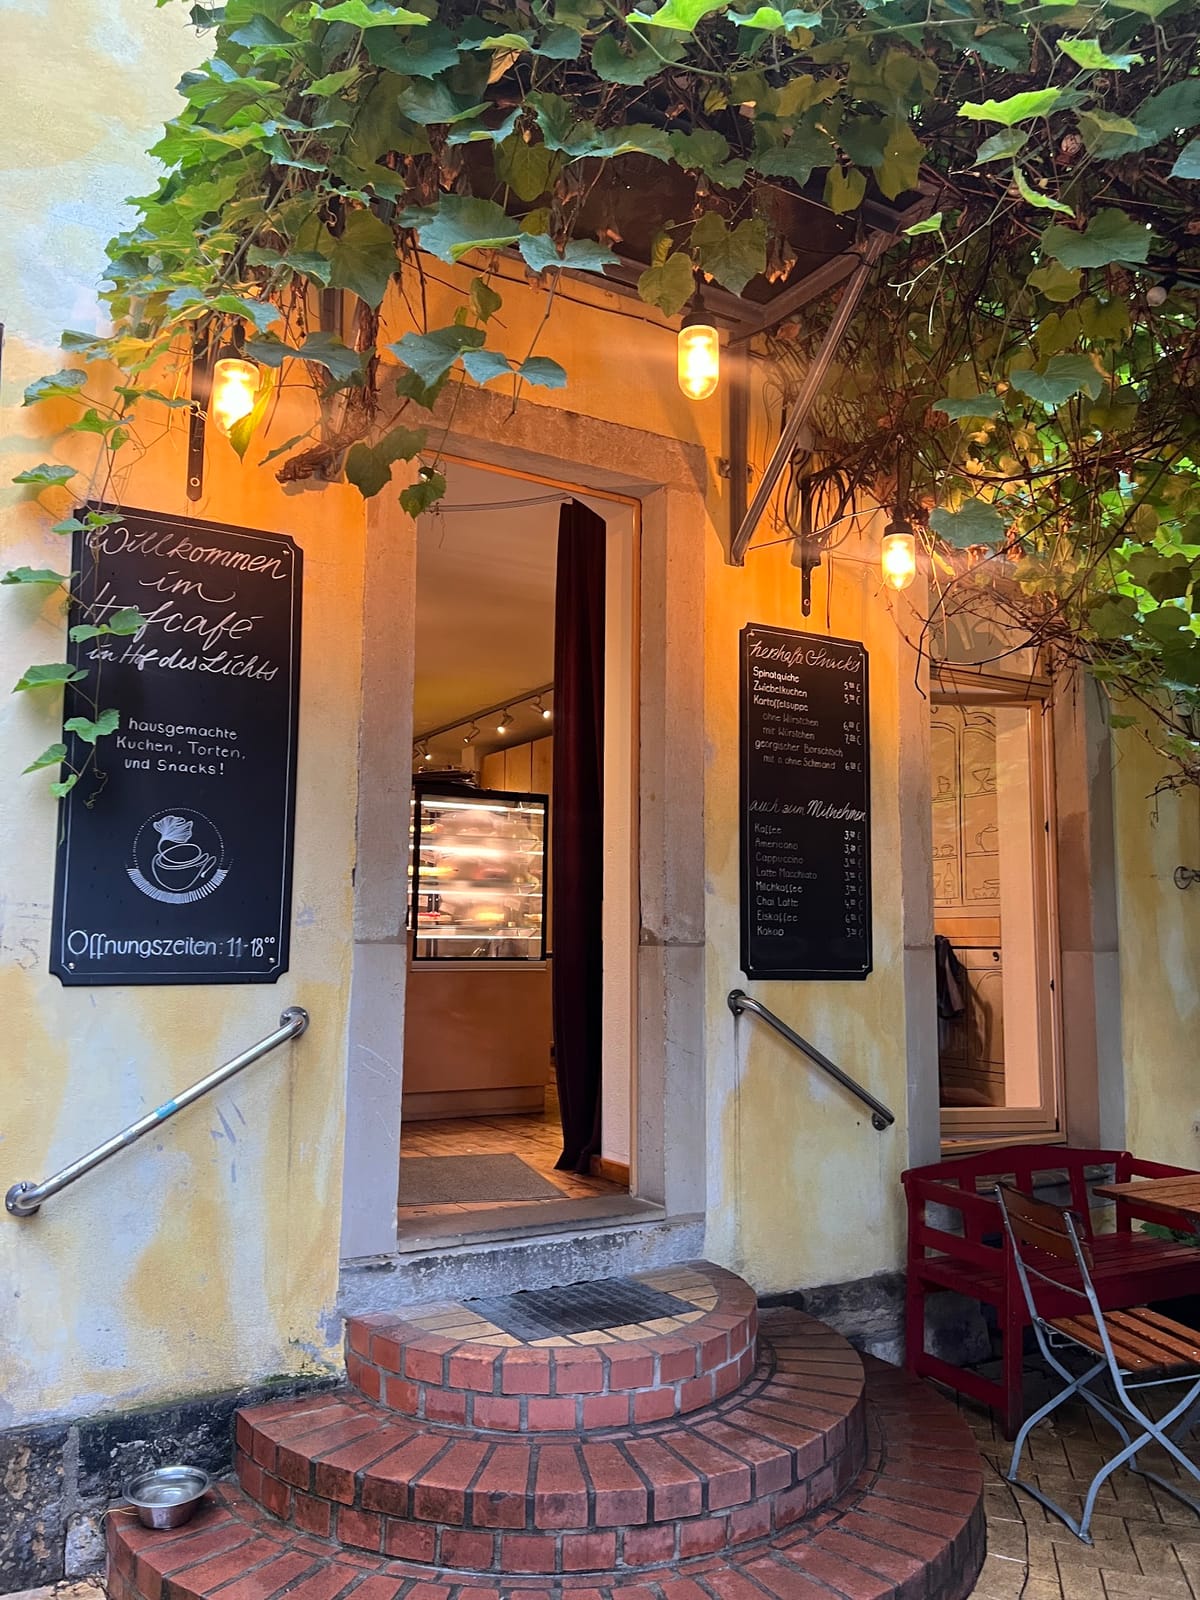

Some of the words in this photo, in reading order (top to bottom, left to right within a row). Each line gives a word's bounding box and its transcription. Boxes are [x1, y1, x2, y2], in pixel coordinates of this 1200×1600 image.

[85, 524, 287, 579] Willkommen
[139, 571, 236, 602] im
[83, 582, 264, 651] Hfcafé
[159, 650, 197, 669] des
[199, 651, 279, 680] Lichts
[753, 680, 808, 698] Zwiebelkuchen
[753, 695, 809, 712] Kartoffelsuppe
[129, 717, 239, 741] hausgemachte
[124, 759, 150, 770] und
[157, 760, 225, 775] Snacks!
[754, 823, 782, 835] Kaffee
[757, 925, 785, 936] Kakao
